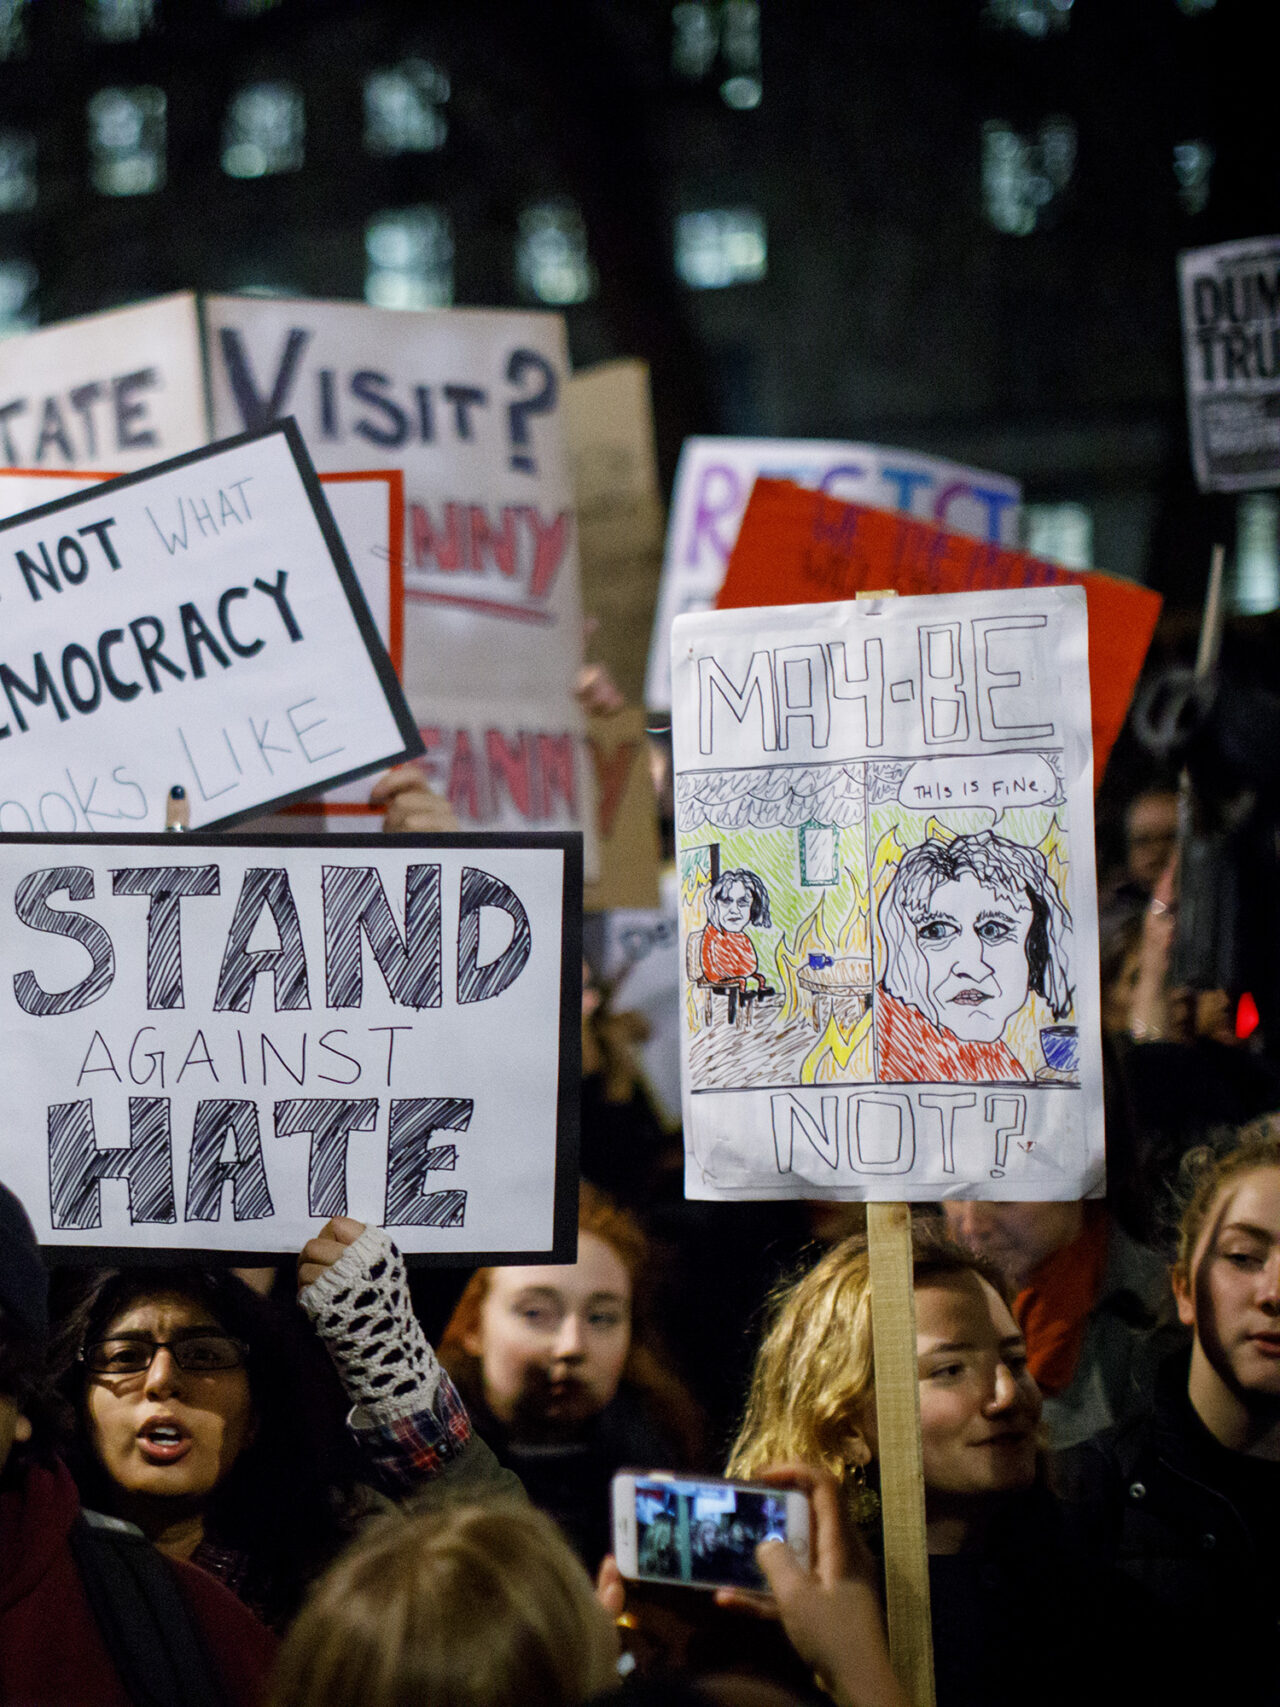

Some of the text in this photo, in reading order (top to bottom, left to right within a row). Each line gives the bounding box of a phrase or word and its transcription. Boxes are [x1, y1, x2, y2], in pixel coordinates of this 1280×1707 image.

[219, 327, 561, 474] VISIT?
[14, 517, 124, 602] NOT
[145, 477, 255, 557] WHAT
[697, 615, 1055, 755] MAY-BE
[178, 698, 346, 801] LIKE
[914, 782, 953, 800] THIS
[963, 780, 979, 796] IS
[13, 864, 532, 1017] STAND
[76, 1026, 413, 1088] AGAINST
[47, 1096, 474, 1230] HATE
[770, 1092, 1026, 1179] NOT?
